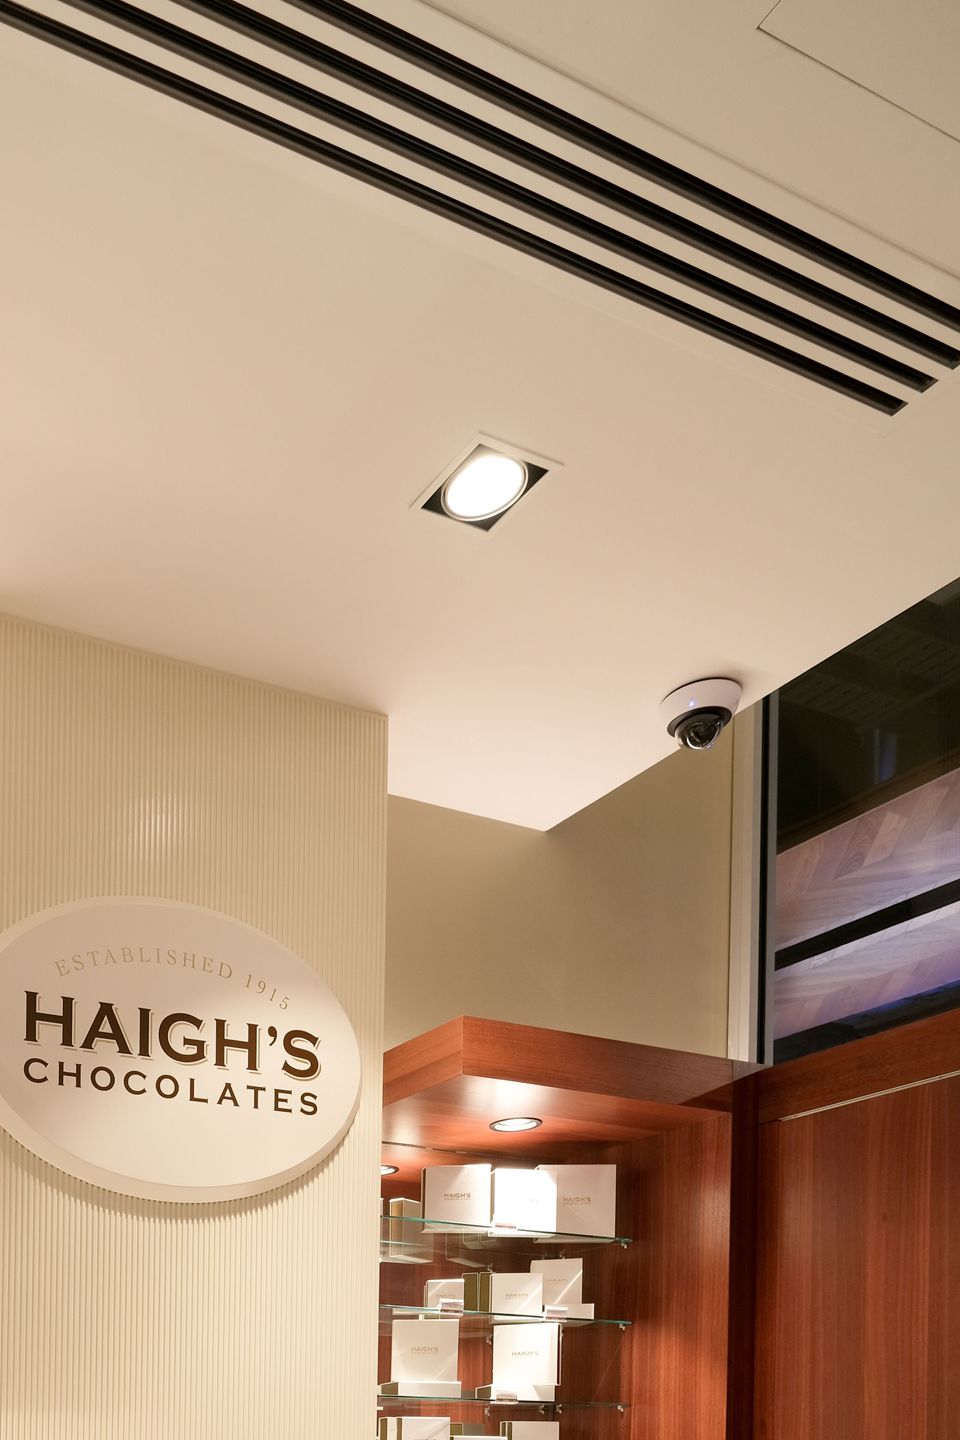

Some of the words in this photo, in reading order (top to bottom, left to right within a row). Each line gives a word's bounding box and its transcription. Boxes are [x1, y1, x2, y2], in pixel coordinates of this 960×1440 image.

[54, 946, 234, 979] ESTABLISHED
[245, 973, 291, 1011] 1915
[23, 989, 321, 1079] HAIGH'S
[23, 1057, 319, 1116] CHOCOLATES
